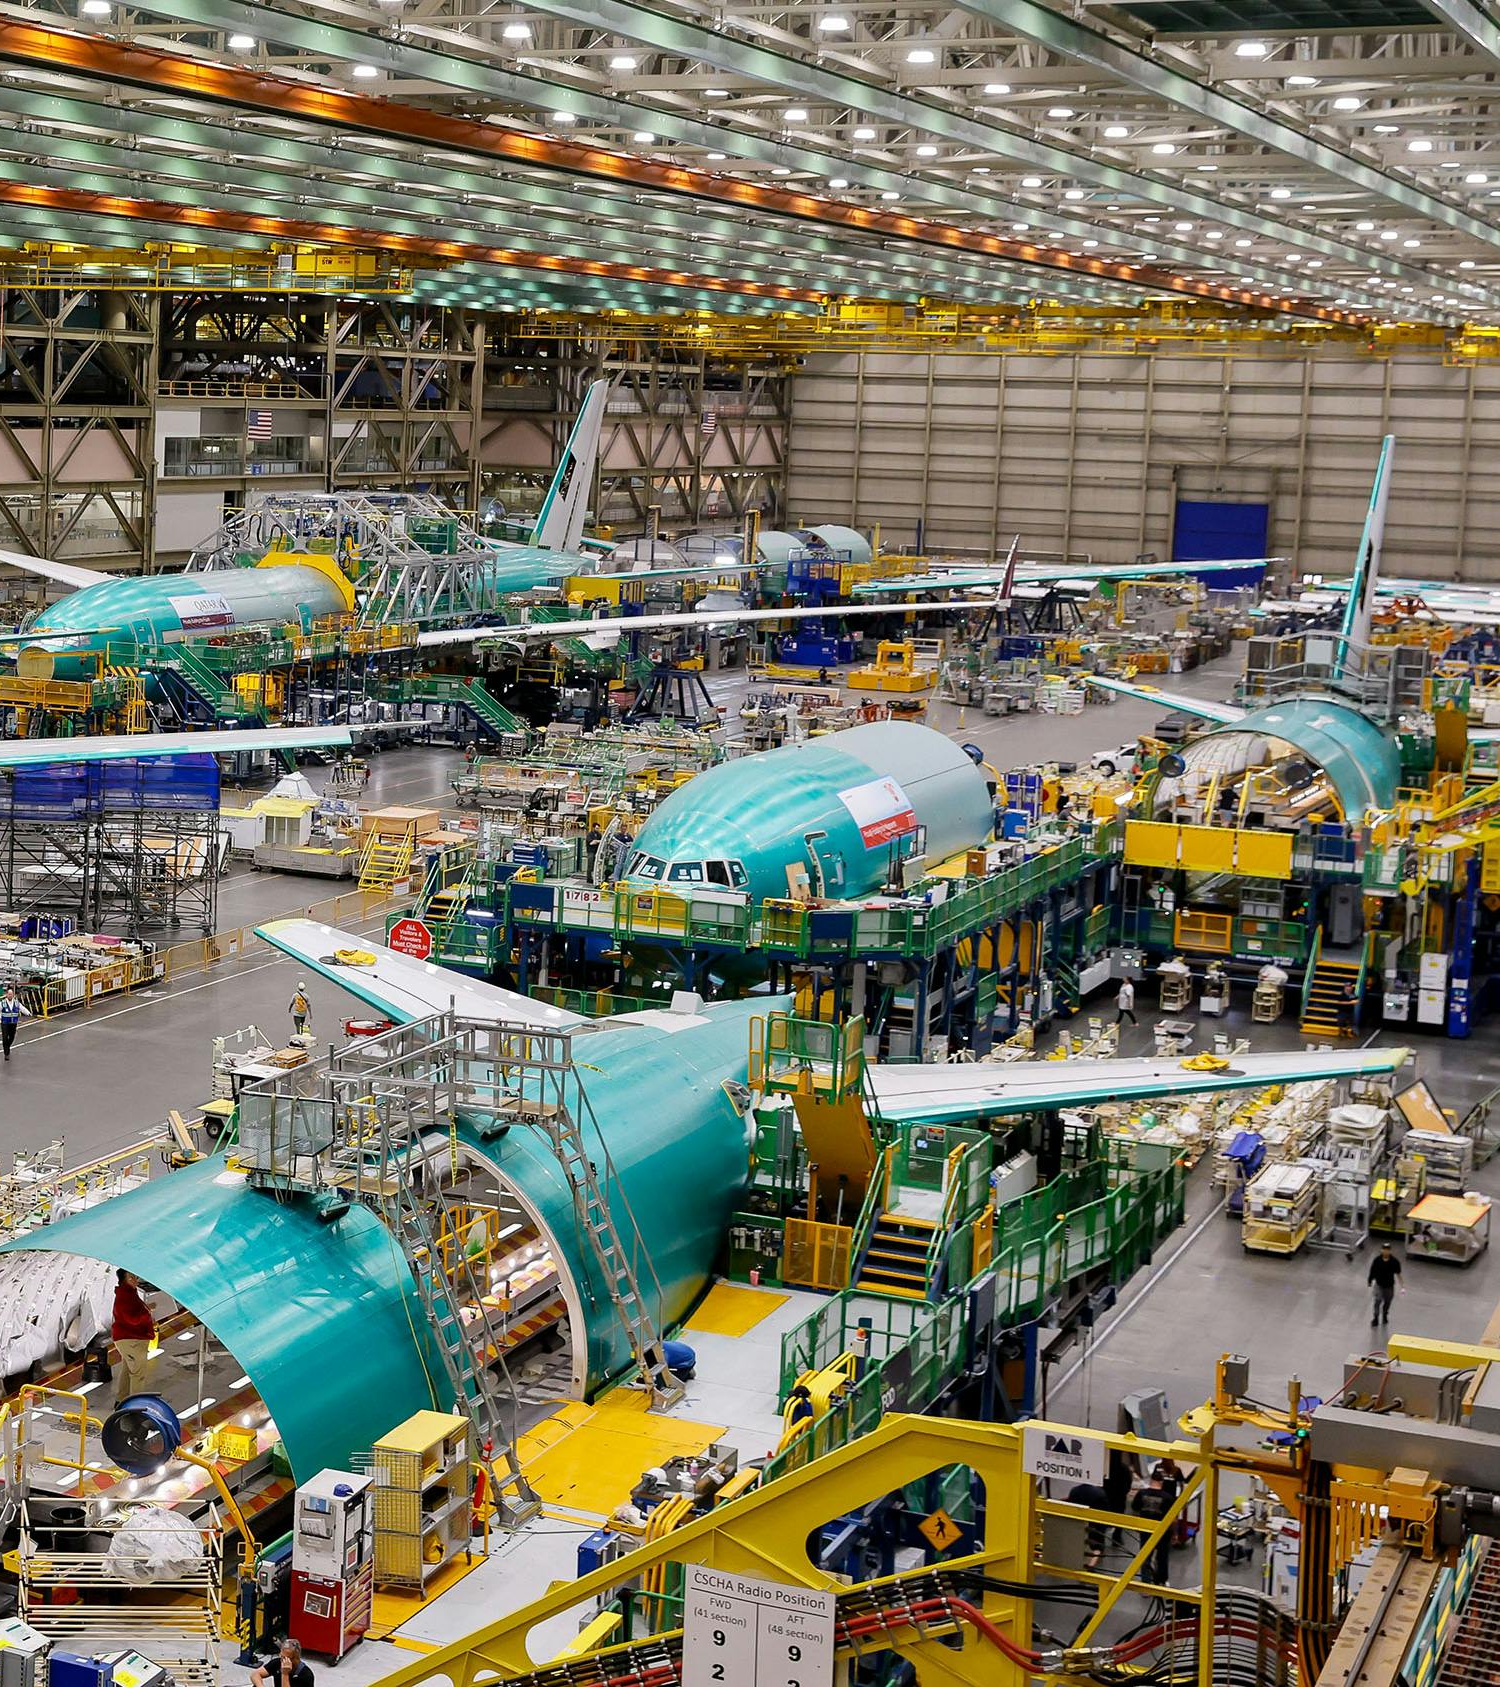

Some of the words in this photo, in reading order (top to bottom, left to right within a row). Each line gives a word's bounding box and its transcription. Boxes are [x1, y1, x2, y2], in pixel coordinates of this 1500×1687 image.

[565, 891, 600, 902] 1782
[399, 929, 418, 937] Visitors
[392, 940, 405, 948] Must
[405, 942, 422, 950] Check
[1045, 1435, 1083, 1456] PAR
[1036, 1461, 1082, 1478] POSITION
[1086, 1470, 1090, 1479] 1
[694, 1572, 734, 1591] CSCHA
[737, 1582, 772, 1600] Radio
[775, 1591, 826, 1610] Position
[709, 1598, 732, 1610] FWD
[694, 1607, 708, 1617] (41
[711, 1611, 747, 1628] section)
[787, 1615, 805, 1625] AFT
[713, 1630, 726, 1646] 9
[767, 1624, 784, 1635] (48
[786, 1629, 823, 1644] section)
[788, 1645, 802, 1662] 9
[711, 1664, 725, 1681] 2
